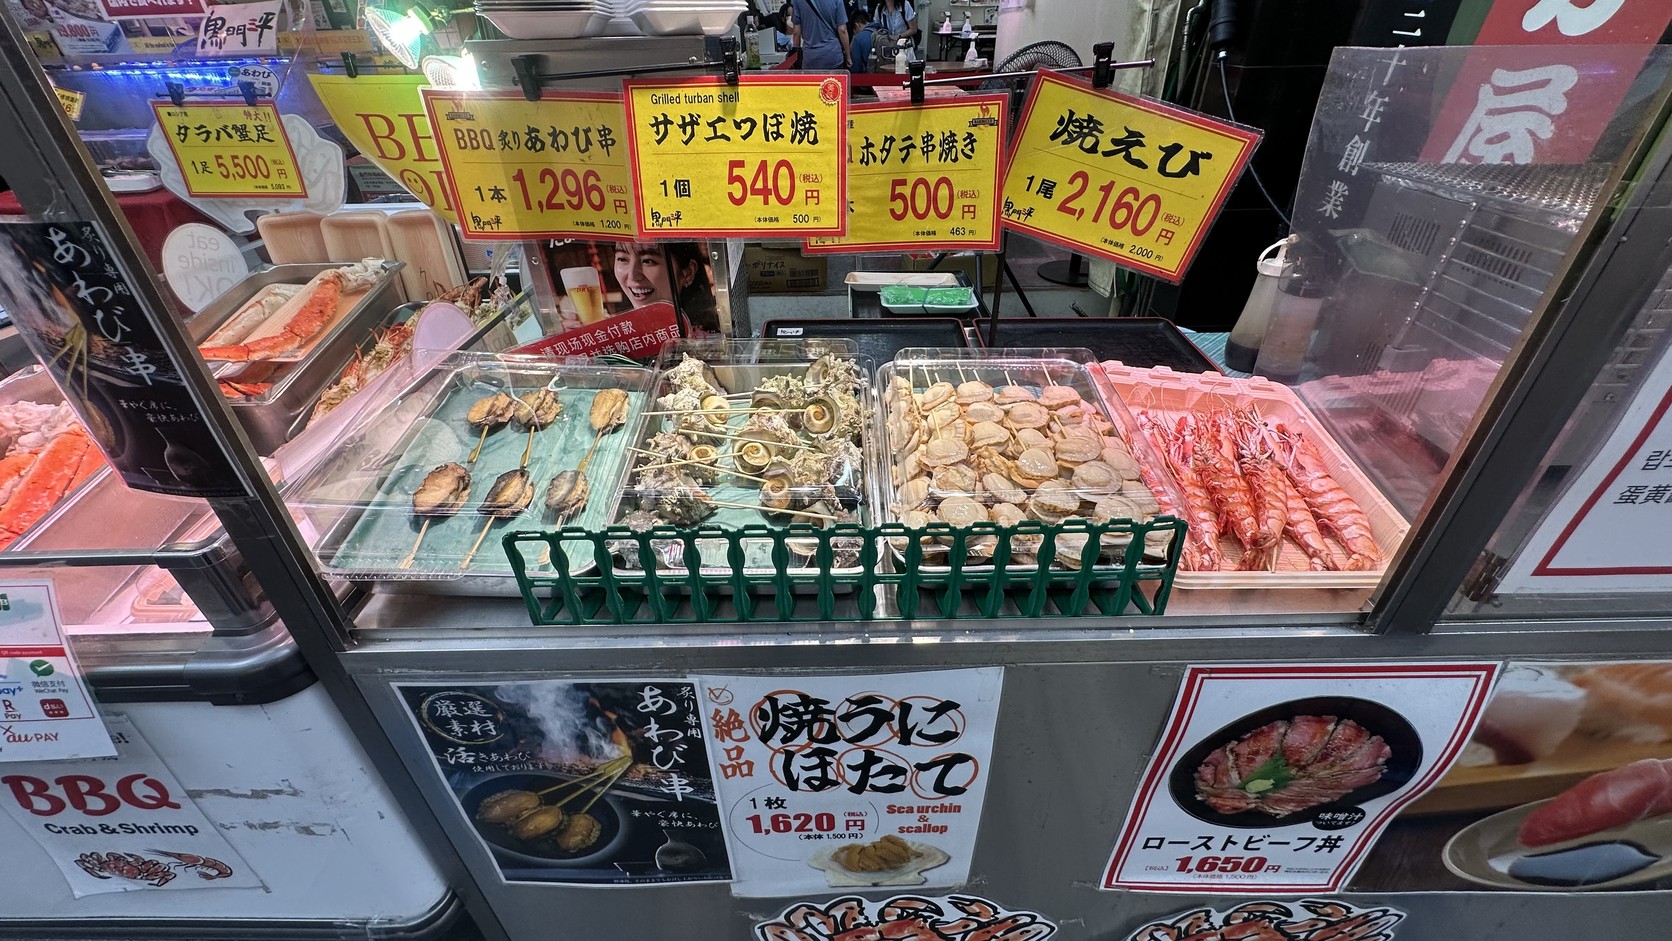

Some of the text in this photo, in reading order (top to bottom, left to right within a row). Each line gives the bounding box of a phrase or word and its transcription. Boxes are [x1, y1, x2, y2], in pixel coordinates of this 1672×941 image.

[651, 91, 740, 105] Grilled turban shell
[175, 124, 275, 144] タラバ蟹足
[453, 128, 496, 151] BBQ
[859, 129, 978, 167] ホタテ串焼き
[1049, 109, 1213, 179] 焼えび
[191, 154, 288, 181] 1足 5,500 円
[659, 158, 820, 207] 1個 540 円
[799, 174, 823, 184] (税込)
[475, 167, 629, 214] 1本 1,296 円
[605, 184, 628, 195] (税込)
[889, 176, 977, 222] 500 円
[956, 189, 980, 199] (税込)
[1025, 170, 1176, 246] 1尾 2,160 円
[792, 214, 810, 224] 500
[1161, 211, 1185, 227] (税込)
[949, 227, 966, 236] 463
[1129, 244, 1154, 259] 2,000
[44, 226, 157, 386] あわび串
[5, 712, 21, 720] Pay
[434, 699, 493, 718] 厳選
[445, 718, 497, 737] 素材
[757, 693, 962, 746] 焼うに
[34, 732, 59, 743] PAY
[637, 685, 695, 802] あわび串
[710, 708, 755, 780] 絶品
[782, 746, 974, 796] ほたて
[1, 773, 182, 817] BBQ
[916, 803, 962, 814] urchin
[745, 812, 865, 836] 1,620 円
[917, 814, 930, 823] &
[44, 822, 199, 836] Crab & Shrimp
[897, 824, 949, 835] scallop
[1141, 834, 1345, 853] ローストビーフ丼
[1175, 856, 1268, 874] 1,650
[1264, 864, 1282, 873] 円
